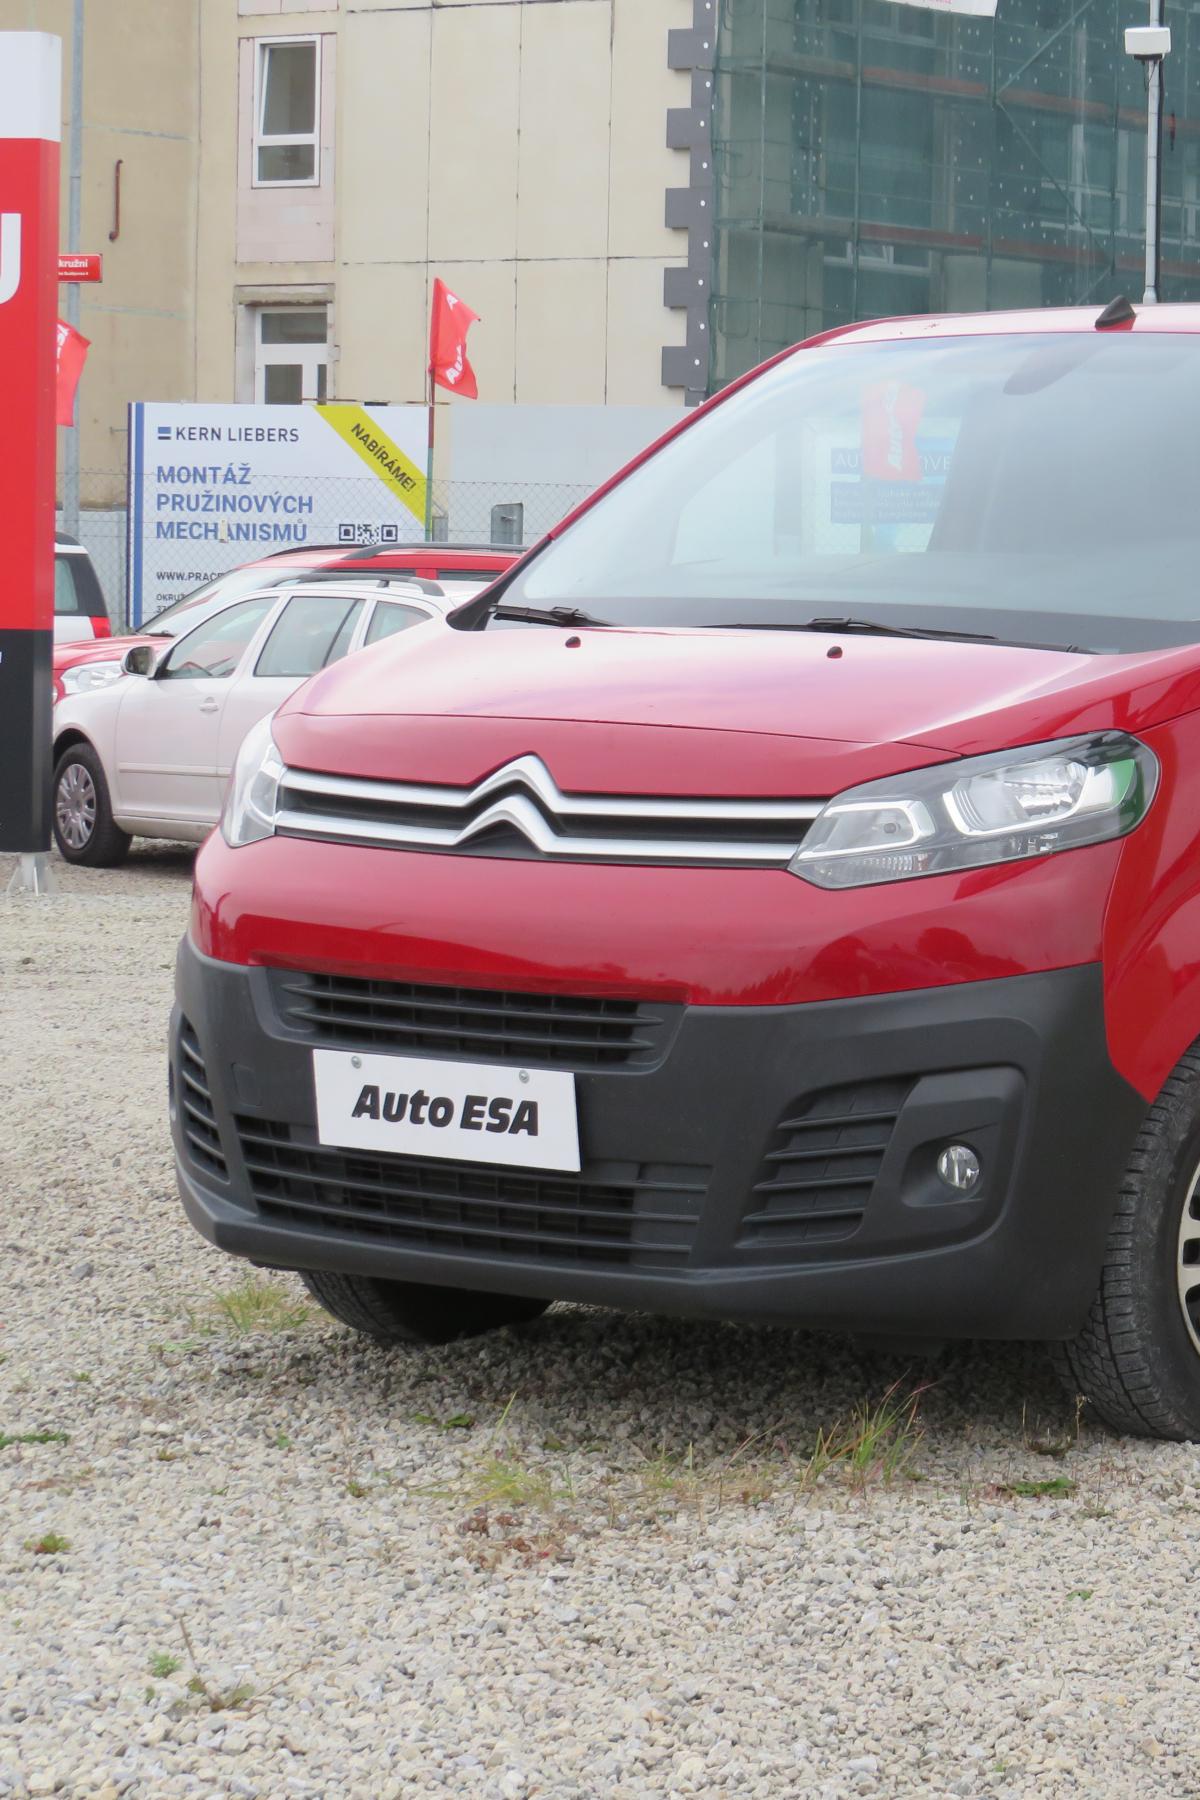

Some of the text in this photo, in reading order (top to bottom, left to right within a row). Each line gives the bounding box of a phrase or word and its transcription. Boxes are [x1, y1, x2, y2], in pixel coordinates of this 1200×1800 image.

[58, 259, 88, 268] kružní
[176, 426, 300, 442] KERN LIEBERS
[351, 422, 417, 492] NABÍRÁME!
[156, 462, 252, 485] MONTÁŽ
[156, 489, 313, 514] PRUŽINOVÝCH
[351, 1084, 539, 1137] Auto ESA
